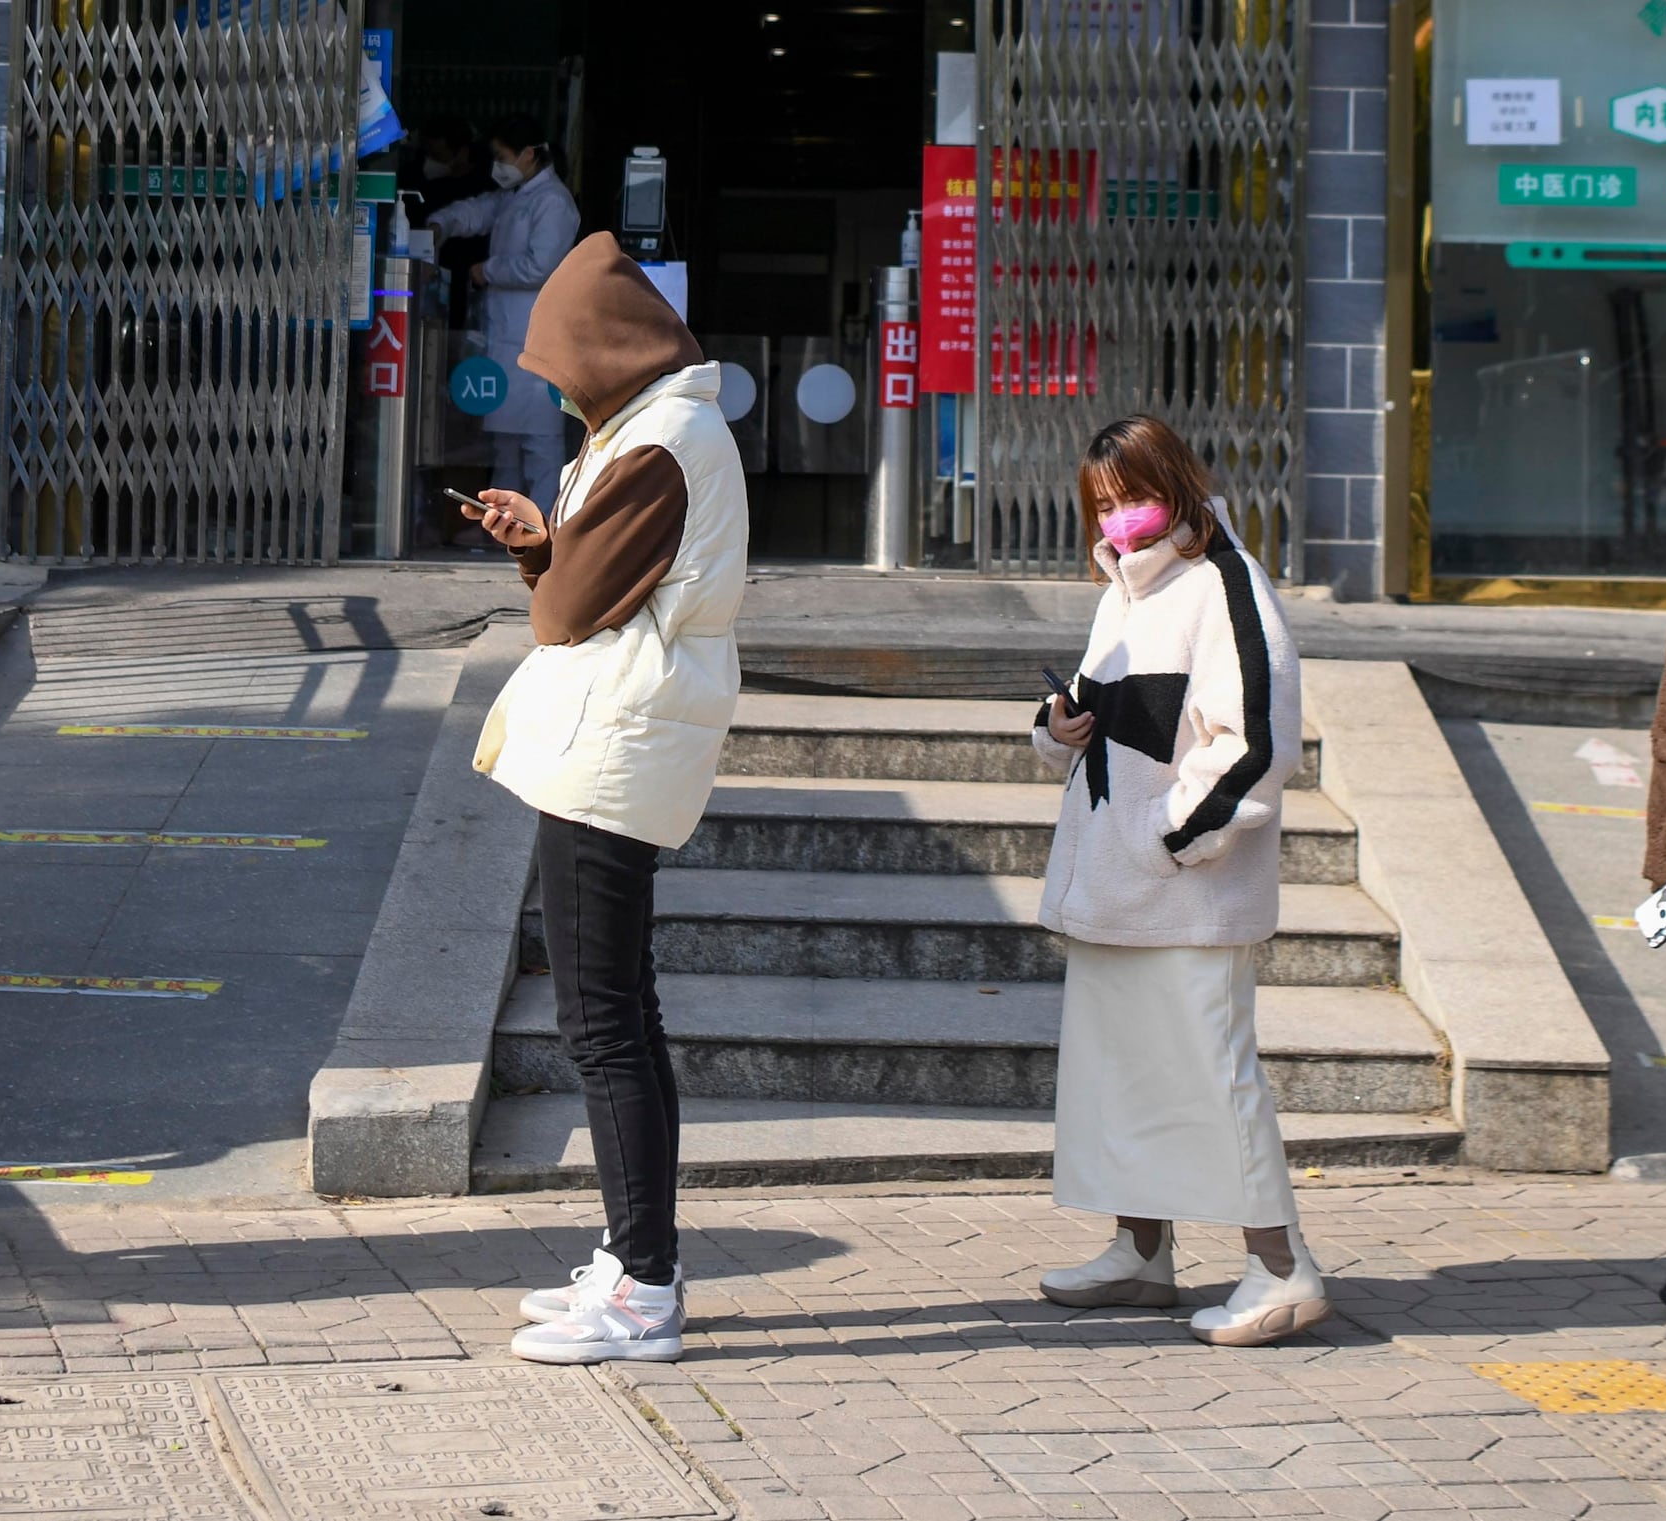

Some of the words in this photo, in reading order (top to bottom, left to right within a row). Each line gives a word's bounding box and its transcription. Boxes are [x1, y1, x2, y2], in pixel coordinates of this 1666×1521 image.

[1513, 172, 1623, 201] 中医门诊
[369, 315, 404, 394] 入口
[885, 325, 918, 405] 出口
[460, 375, 497, 399] 入口
